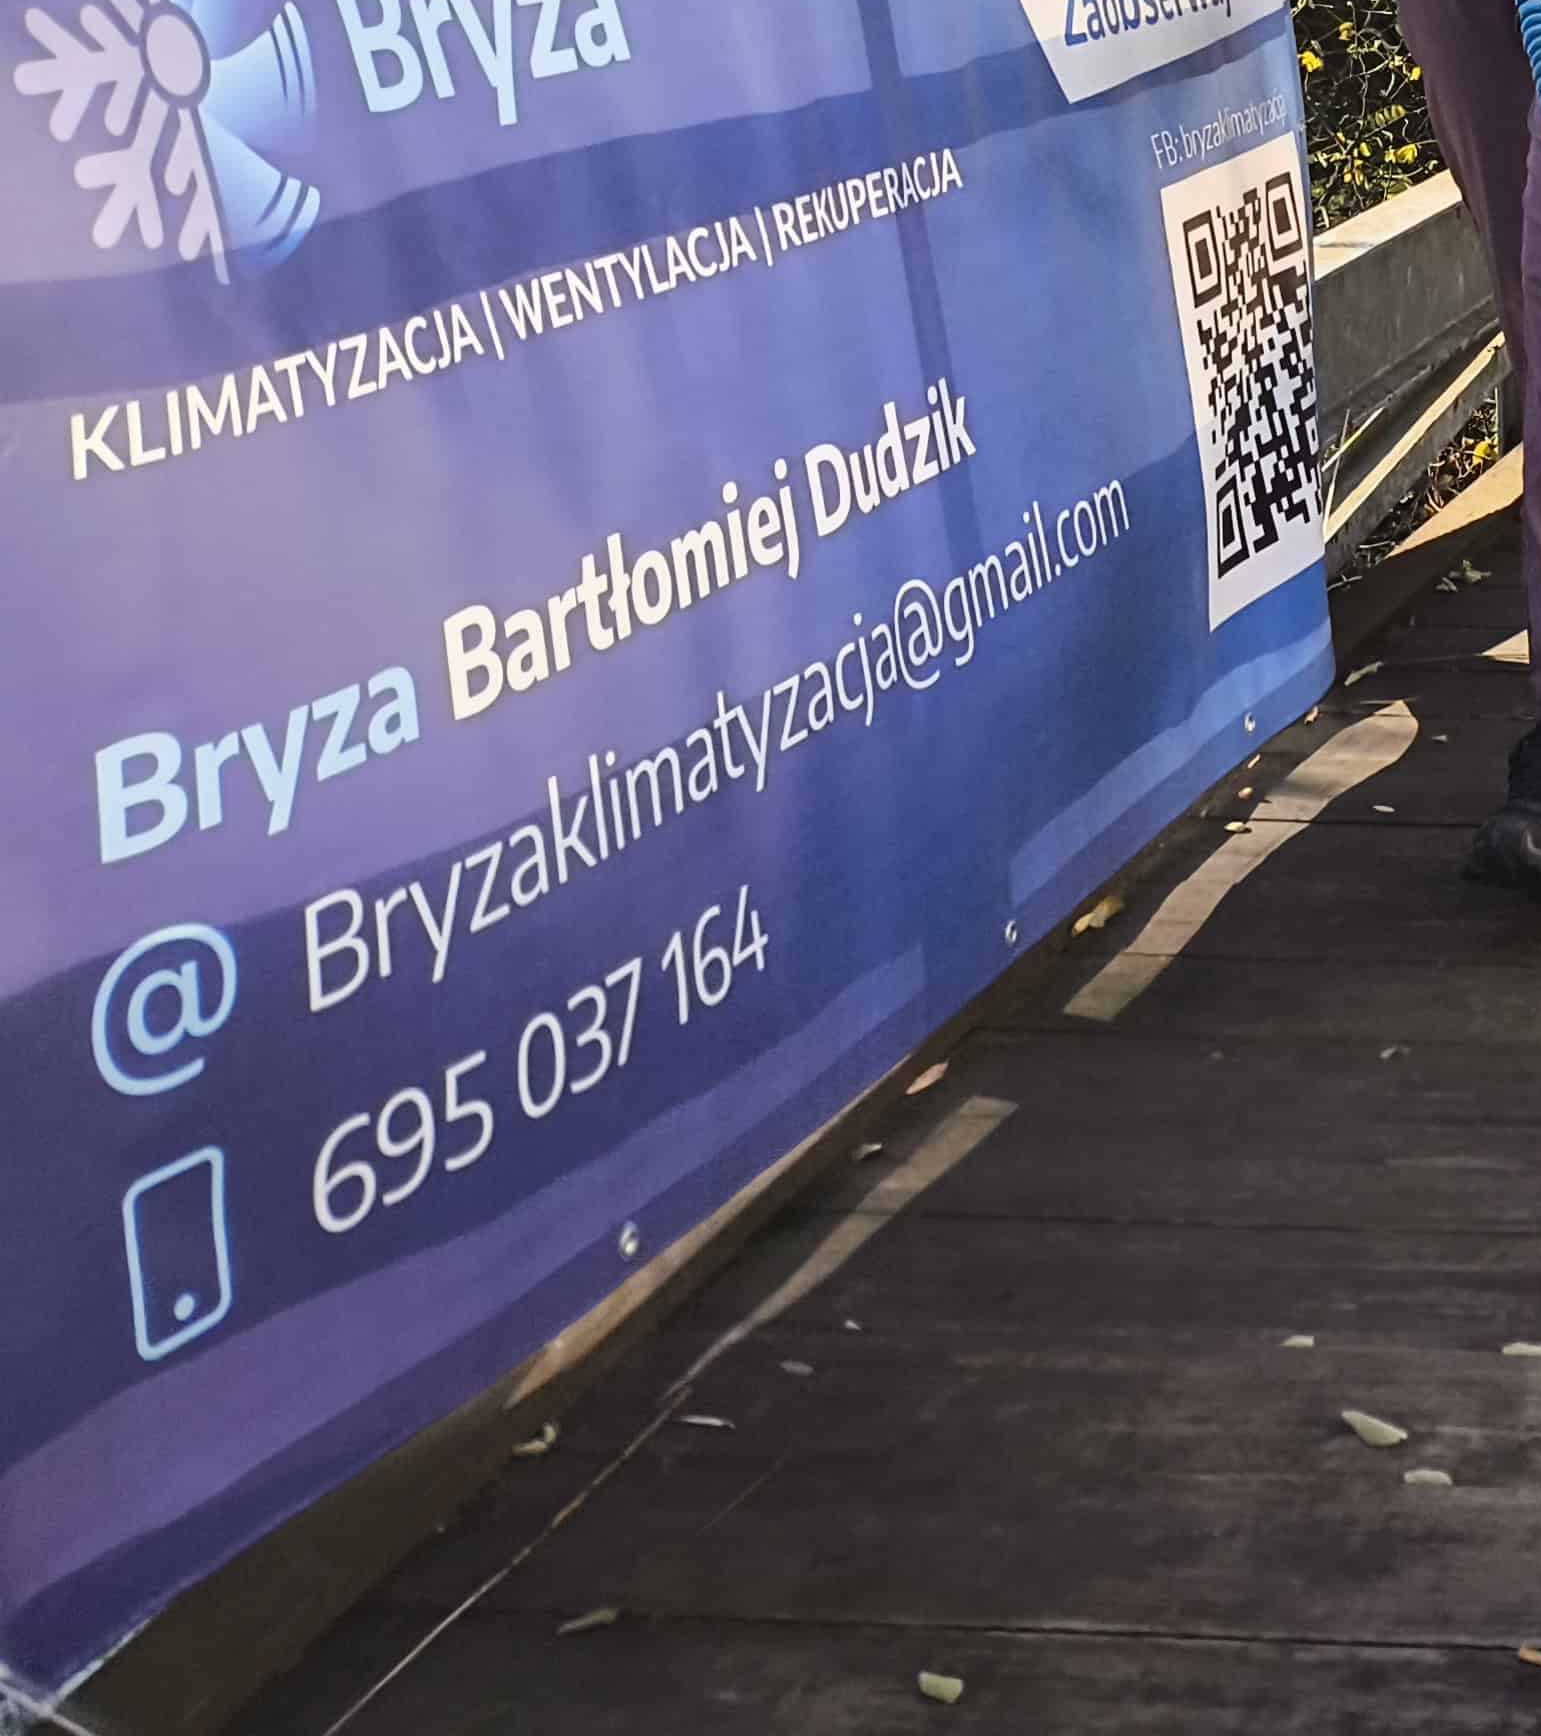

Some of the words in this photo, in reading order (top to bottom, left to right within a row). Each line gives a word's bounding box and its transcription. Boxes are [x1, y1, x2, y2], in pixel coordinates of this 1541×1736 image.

[68, 318, 485, 481] KLIMATYZACJA
[500, 217, 757, 344] WENTYLACJA
[774, 146, 963, 253] REKUPERACJA
[1150, 131, 1184, 169] FB:
[93, 667, 421, 864] Bryza
[442, 460, 802, 721] Bartłomiej
[802, 379, 976, 539] Dudzik
[302, 471, 1131, 1015] Bryzaklimatyzacja@gmail.com
[311, 1050, 498, 1236] 695
[514, 958, 642, 1119] 037
[660, 884, 769, 1034] 164
